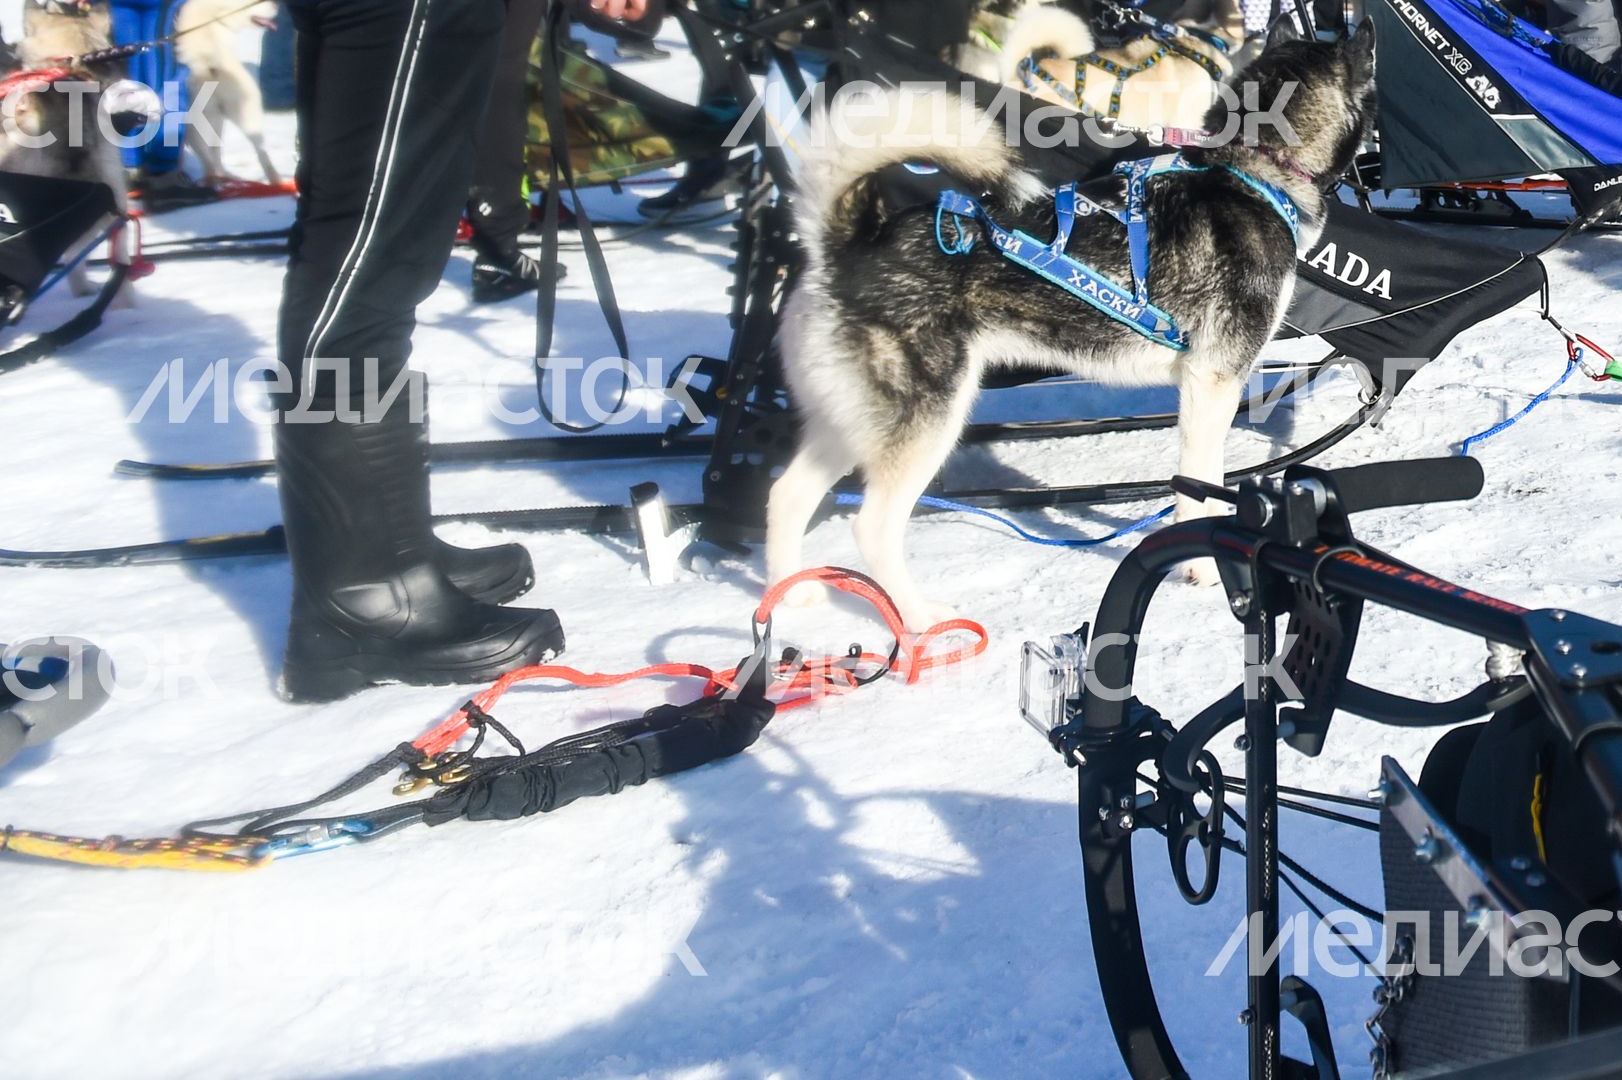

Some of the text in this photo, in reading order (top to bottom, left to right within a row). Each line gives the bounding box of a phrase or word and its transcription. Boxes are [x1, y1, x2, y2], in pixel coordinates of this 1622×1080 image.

[1443, 47, 1473, 75] XC
[1067, 267, 1141, 319] ХАСКИ
[1297, 241, 1393, 301] ADA
